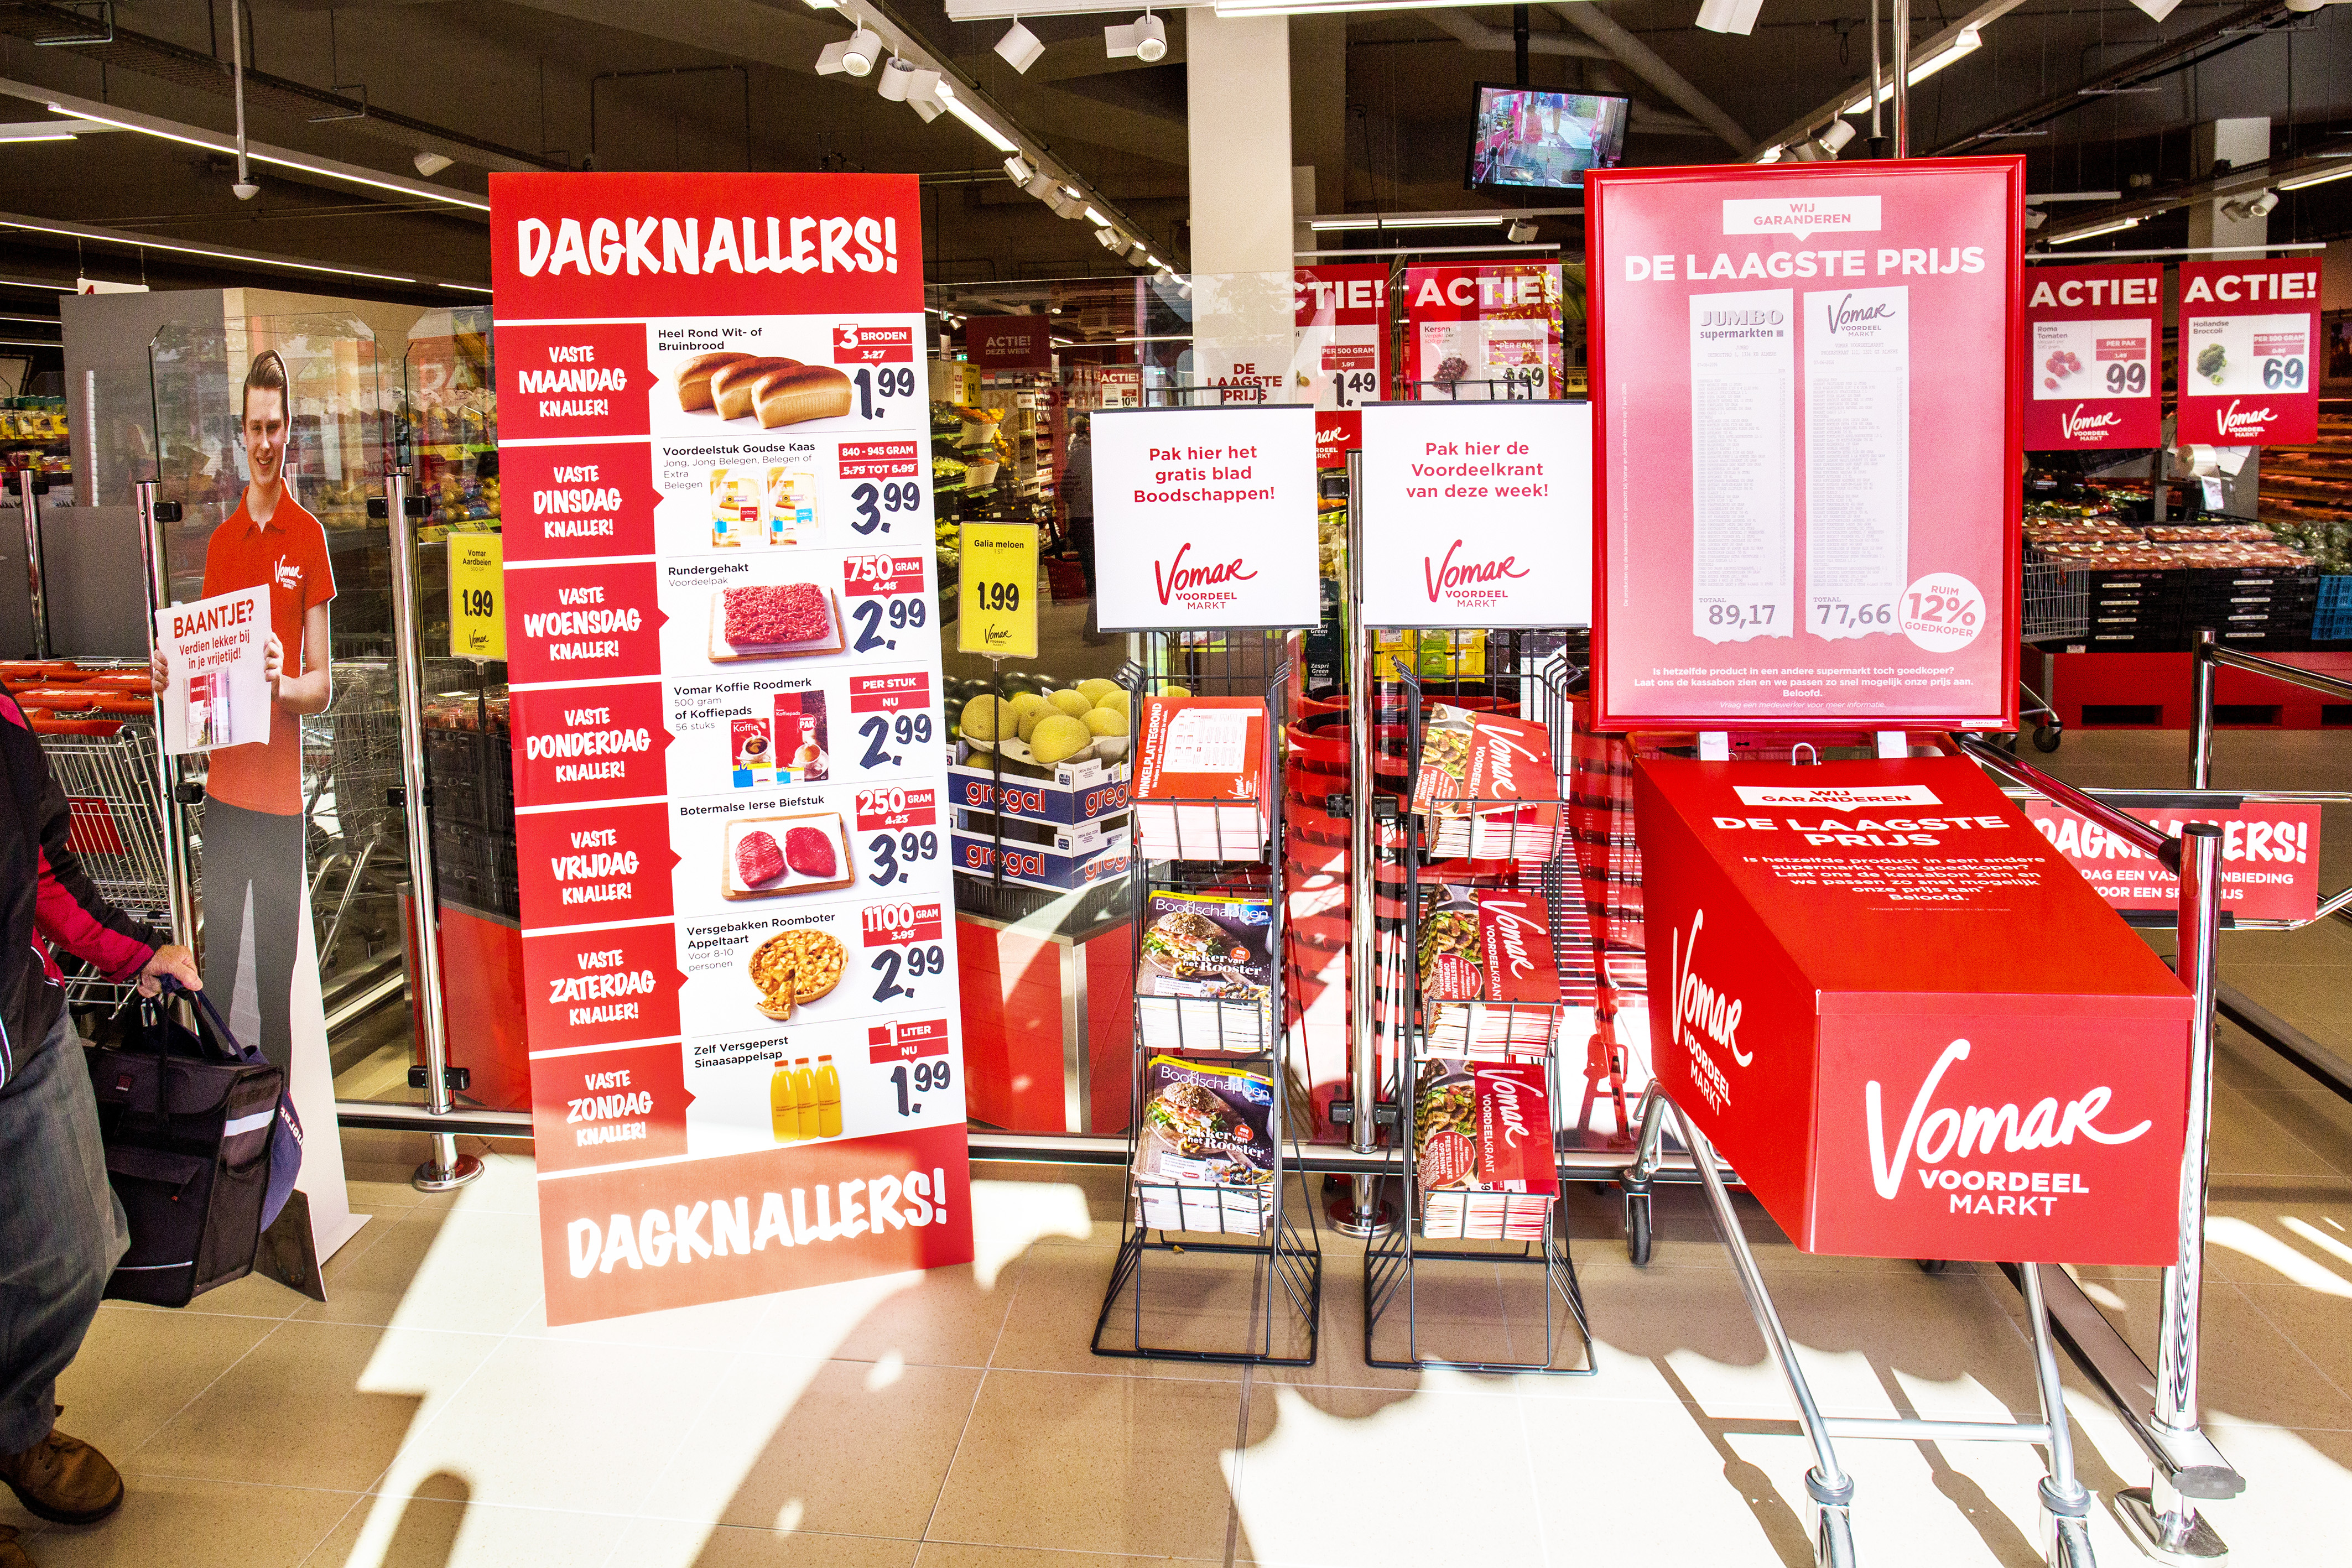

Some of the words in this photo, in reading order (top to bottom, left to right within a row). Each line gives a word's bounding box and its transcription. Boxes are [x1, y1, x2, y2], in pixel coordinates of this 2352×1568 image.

[1790, 204, 1814, 212] WIJ
[1754, 214, 1850, 225] GARANDEREN
[518, 216, 897, 277] DAGKNALLERS!
[1625, 256, 1674, 282] DE
[1687, 250, 1865, 279] LAAGSTE
[1877, 247, 1985, 275] PRIJS
[1414, 278, 1554, 306] ACTIE!
[2030, 278, 2157, 306] ACTIE!
[2184, 273, 2316, 303] ACTIE!
[1701, 310, 1783, 326] JUMBO
[1828, 294, 1895, 334] Vomar
[659, 329, 684, 338] Heel
[688, 329, 717, 337] Rond
[839, 324, 858, 348] 3
[861, 332, 907, 340] BRODEN
[986, 336, 1031, 347] ACTIE!
[1700, 328, 1773, 341] supermarkten
[549, 346, 594, 363] VASTE
[659, 341, 724, 351] Bruinbrood
[1321, 346, 1336, 356] PER
[1353, 346, 1375, 355] GRAM
[1101, 373, 1139, 382] ACTIE!
[1234, 363, 1255, 374] DE
[2106, 363, 2146, 393] 99
[2263, 358, 2304, 390] 69
[519, 368, 627, 394] MAANDAG
[1208, 376, 1282, 388] LAAGSTE
[1333, 373, 1375, 408] 1.49
[854, 368, 914, 420] 1.99
[1223, 389, 1267, 401] PRIJS
[540, 399, 608, 417] KNALLER!
[663, 445, 739, 455] Voordeelstuk
[743, 444, 785, 453] Goudse
[1150, 447, 1181, 461] Pak
[1188, 447, 1222, 460] hier
[1229, 446, 1257, 459] het
[1427, 442, 1458, 455] Pak
[1466, 442, 1500, 455] hier
[1507, 441, 1528, 455] de
[719, 457, 759, 466] Belegen,
[1412, 463, 1543, 476] Voordeelkrant
[1156, 467, 1206, 484] gratis
[1213, 466, 1251, 480] blad
[1135, 487, 1274, 503] Boodschappen!
[1407, 487, 1438, 498] van
[1445, 485, 1488, 497] deze
[1495, 483, 1548, 497] week!
[534, 488, 622, 514] DINSDAG
[851, 482, 920, 535] 3.99
[274, 555, 303, 583] Vomar
[669, 564, 748, 575] Rundergehakt
[847, 556, 893, 581] 750
[895, 562, 919, 571] GRAM
[1155, 543, 1257, 605] Vomar
[669, 577, 728, 586] Voordeelpak
[1932, 586, 1959, 595] RUIM
[463, 590, 493, 617] 1.99
[977, 582, 1019, 611] 1.99
[174, 599, 254, 639] BAANTJE?
[1709, 605, 1775, 629] 89,17
[1817, 604, 1891, 628] 77,66
[1909, 593, 1975, 626] 12%
[524, 608, 642, 637] WOENSDAG
[852, 598, 925, 653] 2.99
[1905, 621, 1975, 637] GOEDKOPER
[179, 642, 210, 655] Verdien
[212, 635, 237, 648] lekker
[240, 629, 249, 643] bij
[985, 624, 1012, 644] Vomar
[189, 658, 196, 669] in
[198, 658, 205, 669] je
[207, 648, 241, 665] vrijetijd!
[1710, 668, 1747, 676] product
[1817, 667, 1870, 676] supermarkt
[1897, 666, 1954, 675] goedkoper?
[674, 686, 712, 695] Vomar
[716, 683, 750, 692] Koffie
[753, 678, 811, 690] Roodmerk
[863, 680, 884, 690] PER
[888, 678, 916, 687] STUK
[675, 699, 694, 707] 500
[698, 698, 721, 706] gram
[883, 697, 898, 706] NU
[675, 711, 686, 720] of
[691, 706, 752, 718] Koffiepads
[733, 723, 758, 732] Koffie
[527, 728, 651, 760] DONDERDAG
[858, 714, 932, 769] 2.99
[1138, 703, 1162, 798] WINKELPLATTEGROND
[680, 803, 745, 816] Botermalse
[749, 801, 776, 810] Ierse
[779, 796, 824, 807] Biefstuk
[966, 782, 1045, 813] gregal
[1713, 817, 1778, 830] DE
[1787, 816, 2010, 831] LAAGSTE
[1804, 834, 1940, 846] PRIJS
[551, 851, 639, 881] VRIJDAG
[1156, 899, 1268, 920] Boodschappen
[687, 921, 768, 935] Versgebakken
[772, 914, 835, 926] Roomboter
[688, 935, 748, 949] Appeltaart
[714, 949, 733, 957] 8-10
[1172, 949, 1227, 962] Lekker
[689, 961, 732, 972] personen
[1200, 962, 1262, 975] Rooster
[550, 974, 655, 1003] ZATERDAG
[902, 1025, 931, 1036] LITER
[695, 1045, 716, 1055] Zelf
[720, 1036, 788, 1051] Versgeperst
[695, 1050, 784, 1068] Sinaasappelsap
[891, 1061, 950, 1116] 1.99
[566, 1096, 653, 1123] ZONDAG
[1866, 1039, 2151, 1199] Vomar
[1483, 1094, 1495, 1173] VOORDEELKRANT
[1918, 1169, 2089, 1193] VOORDEEL
[1950, 1194, 2057, 1216] MARKT
[567, 1168, 946, 1279] DAGKNALLERS!
